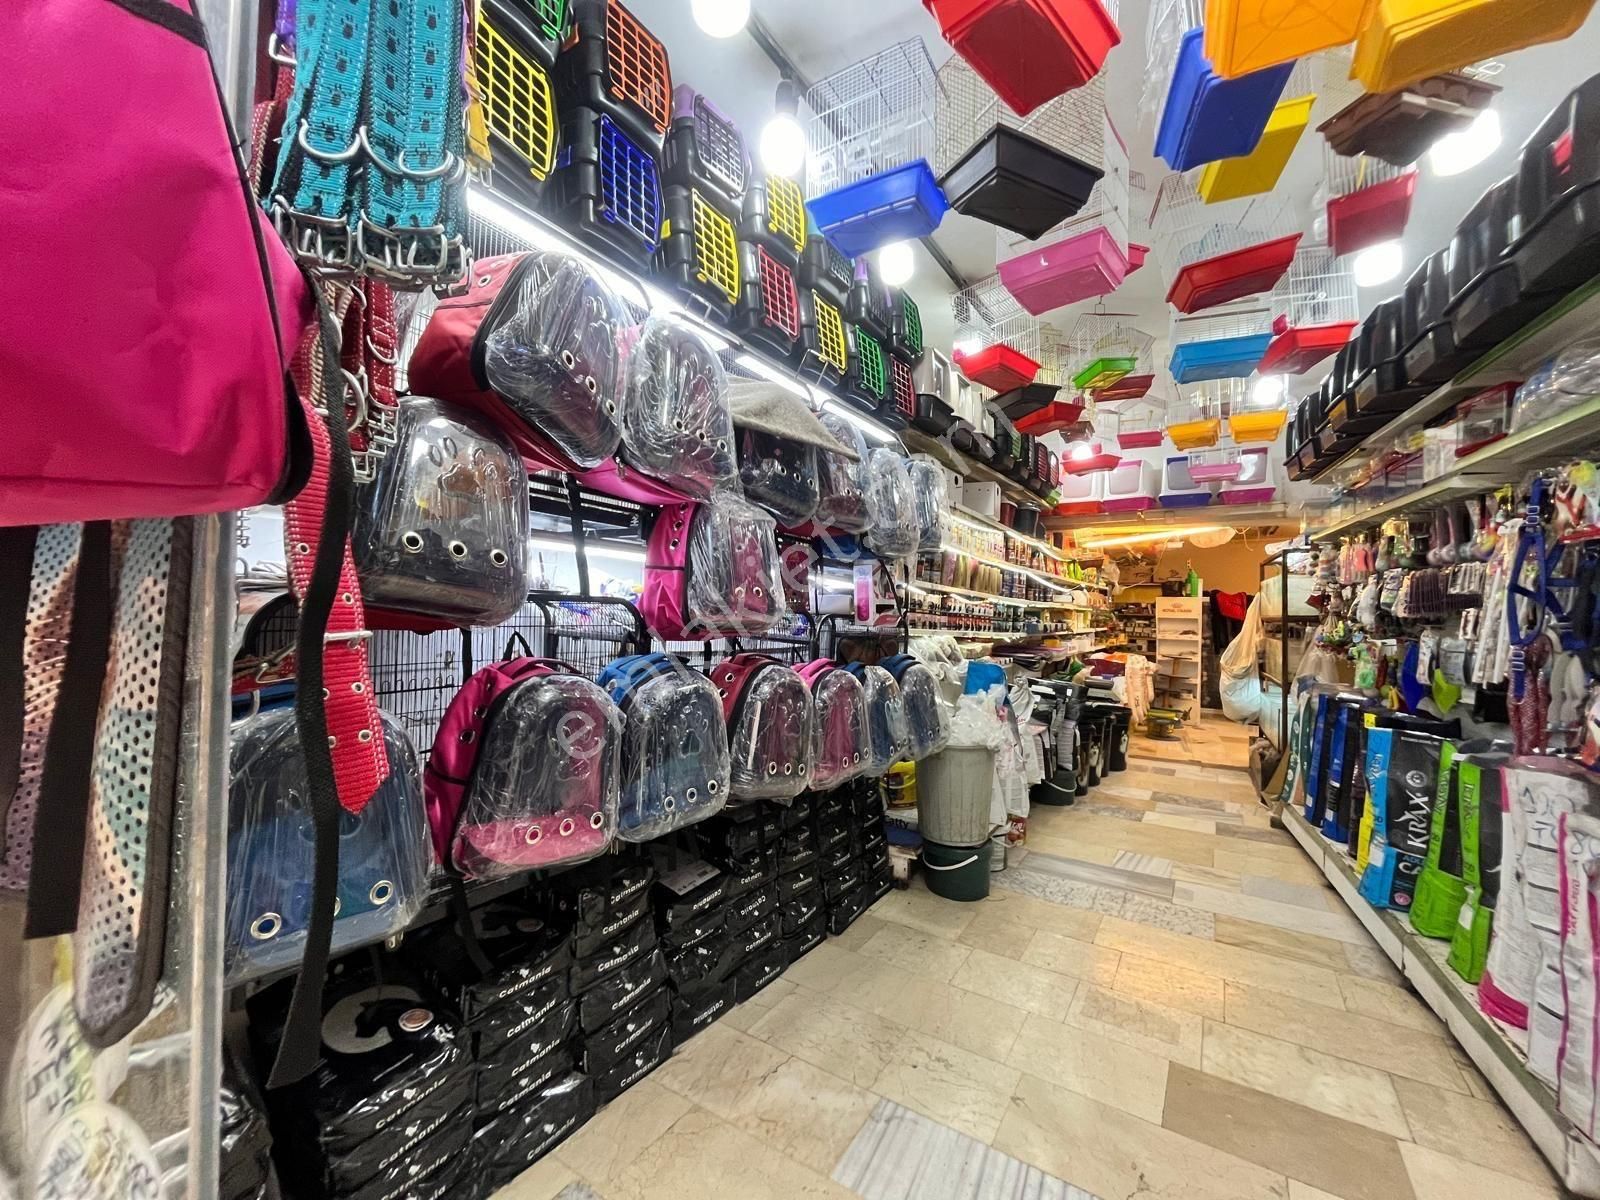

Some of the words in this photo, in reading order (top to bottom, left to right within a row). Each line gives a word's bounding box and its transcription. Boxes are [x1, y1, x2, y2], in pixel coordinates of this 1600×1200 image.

[1393, 789, 1431, 849] KRAX
[598, 945, 639, 972] Catmania
[499, 965, 552, 998] Catmania
[611, 976, 651, 1010] Catmania
[506, 998, 556, 1038] Catmania
[614, 1017, 653, 1053] Catmania
[511, 1038, 560, 1077] Catmania
[375, 1075, 448, 1129] Catmania
[498, 1069, 552, 1111] Catmania
[378, 1112, 448, 1169] Catmania
